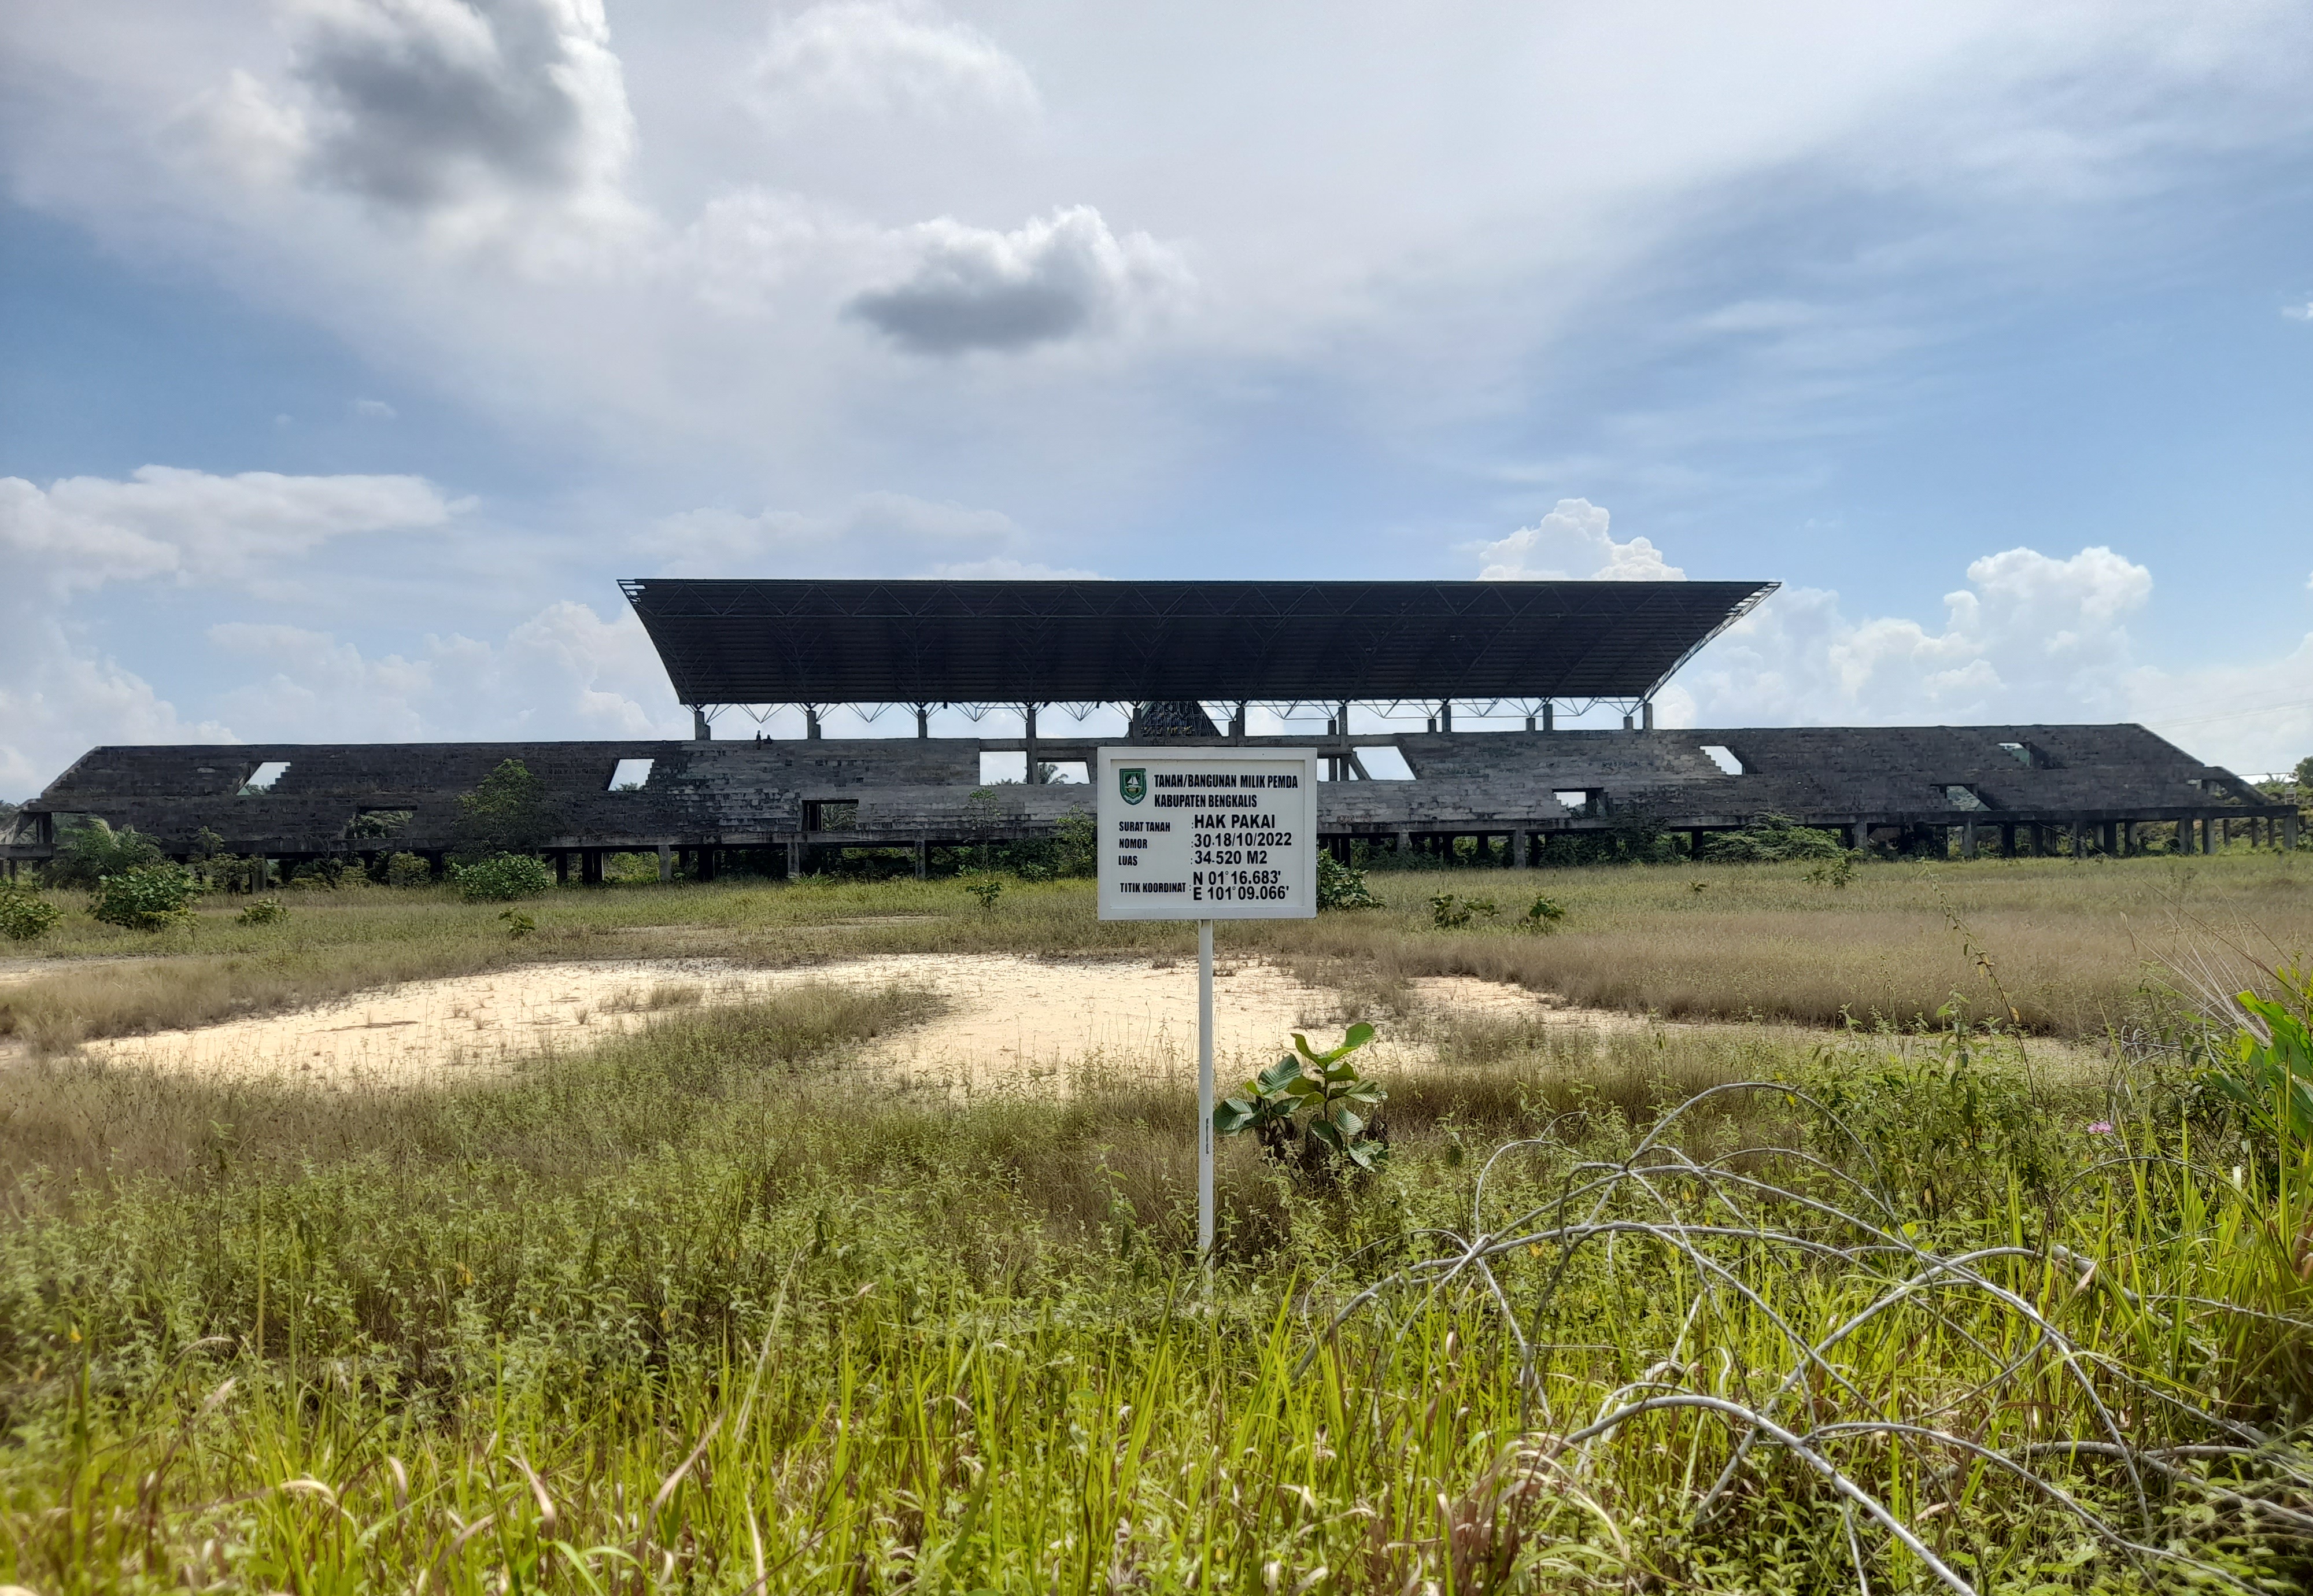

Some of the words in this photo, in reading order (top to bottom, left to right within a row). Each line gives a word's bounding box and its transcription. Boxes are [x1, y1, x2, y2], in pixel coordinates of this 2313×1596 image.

[1154, 774, 1237, 788] TANAH/BANGUNAN
[1240, 774, 1266, 789] MILIK
[1267, 775, 1298, 789] PEMDA
[1154, 794, 1206, 808] KABUPATEN
[1208, 794, 1257, 808] BENGKALIS
[1119, 821, 1144, 832] SURAT
[1145, 821, 1170, 833] TANAH
[1231, 814, 1275, 829] PAKAI
[1119, 838, 1148, 849] NOMOR
[1118, 855, 1138, 866] LUAS
[1247, 850, 1268, 864] M2
[1193, 871, 1203, 885] N
[1119, 882, 1141, 893] TITIK
[1142, 882, 1187, 893] KOORDINAT
[1193, 887, 1202, 901] E
